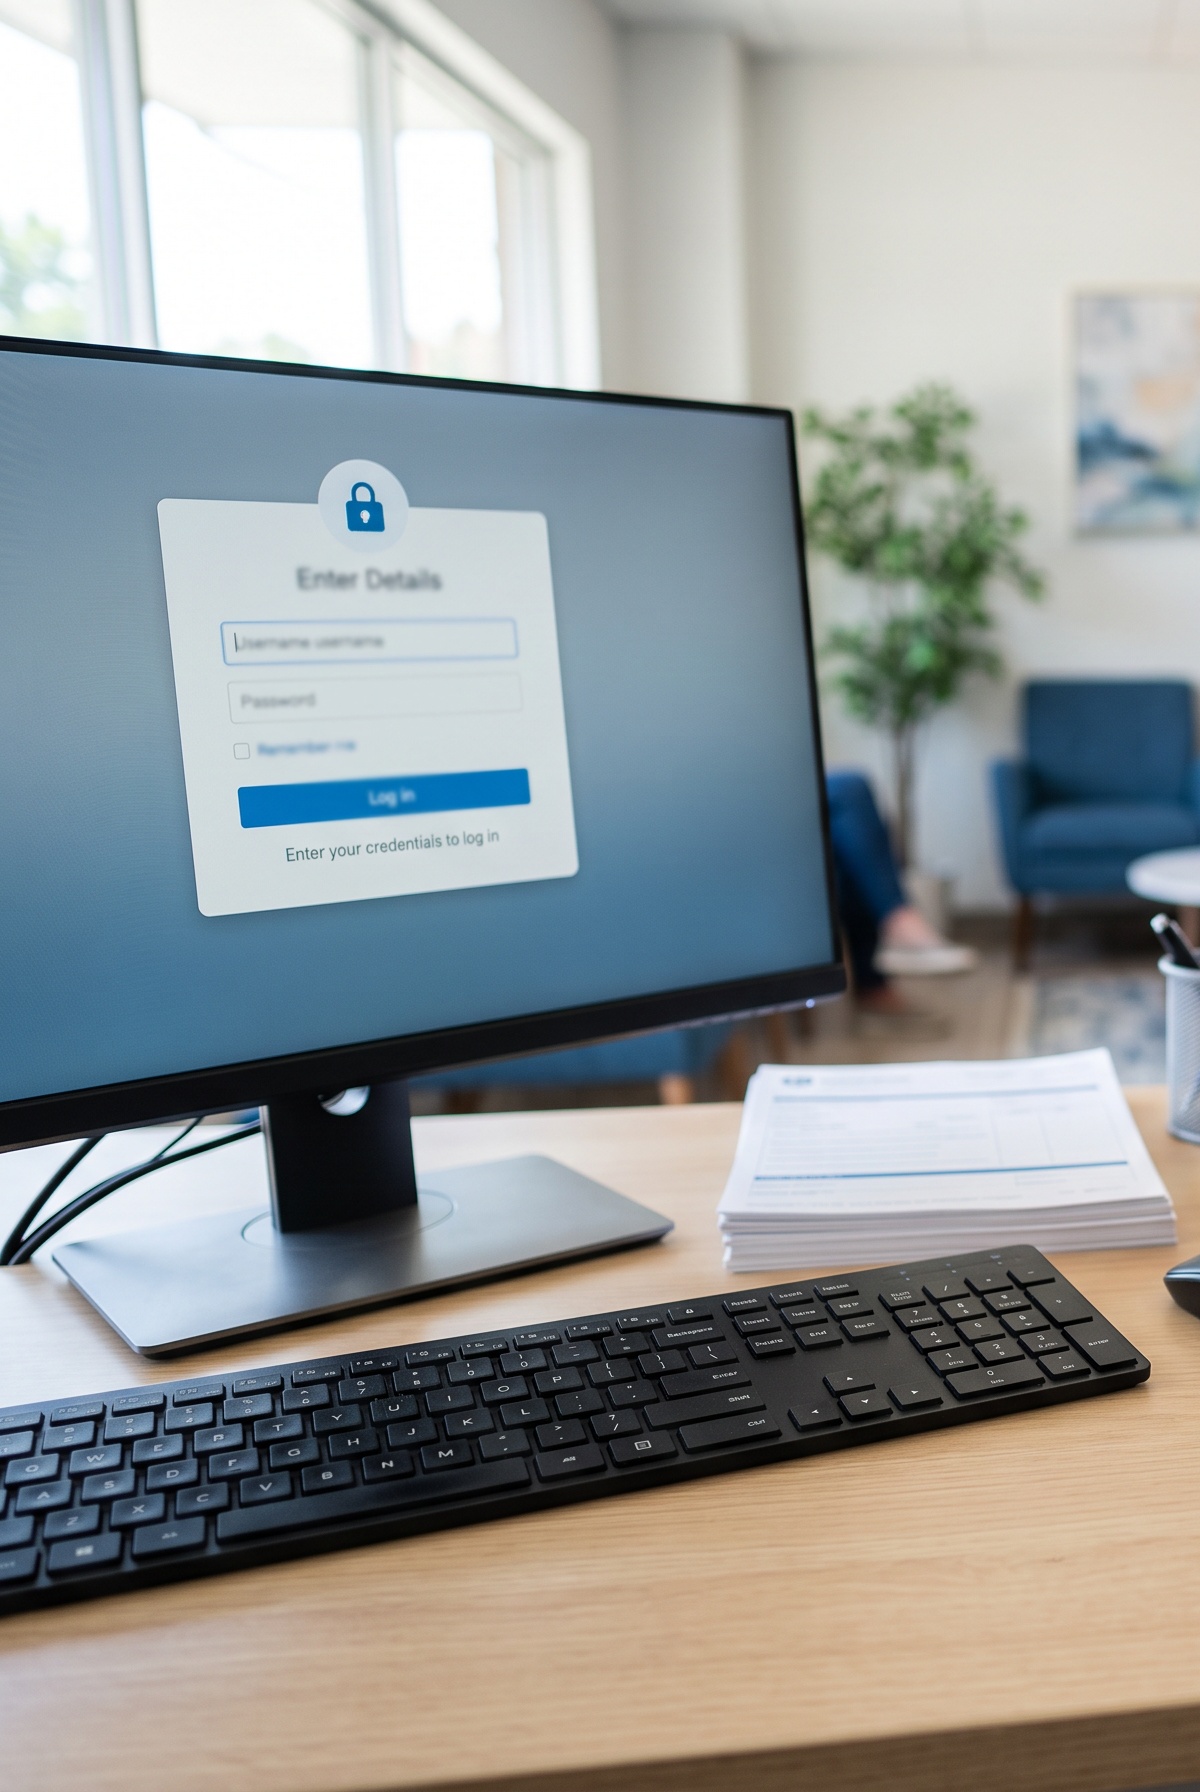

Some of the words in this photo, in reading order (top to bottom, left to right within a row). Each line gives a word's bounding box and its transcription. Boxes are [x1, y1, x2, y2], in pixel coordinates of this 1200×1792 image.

[296, 566, 358, 592] Enter
[364, 566, 443, 593] Details
[368, 789, 398, 808] Log
[400, 786, 417, 803] in
[285, 847, 325, 862] Enter
[329, 844, 362, 861] your
[446, 833, 460, 847] to
[462, 830, 484, 847] log
[487, 828, 500, 843] in
[86, 1453, 105, 1463] W
[438, 1449, 454, 1458] M
